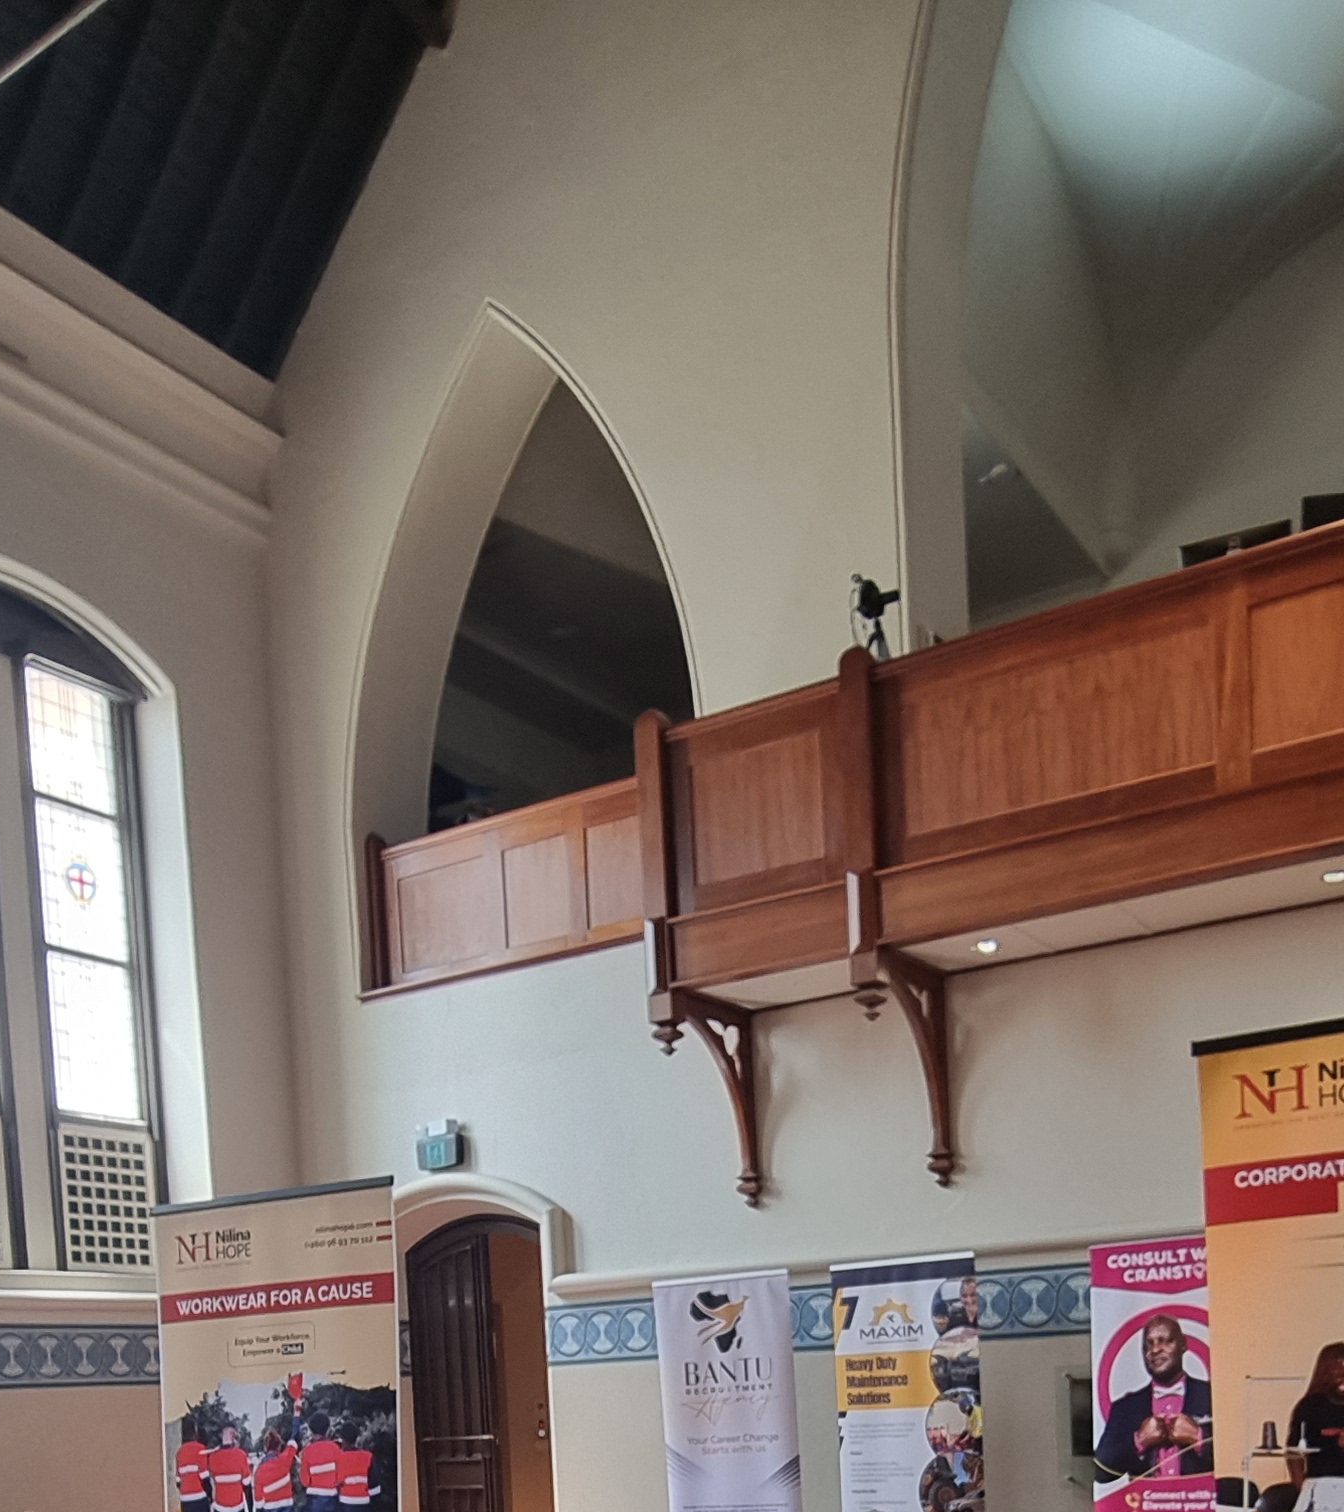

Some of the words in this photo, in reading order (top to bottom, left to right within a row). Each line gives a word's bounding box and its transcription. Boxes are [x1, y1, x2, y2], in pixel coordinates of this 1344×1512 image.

[215, 1227, 251, 1244] Nilina
[216, 1242, 252, 1259] HOPE
[1106, 1248, 1188, 1270] CONSULT
[1123, 1261, 1206, 1284] CRANSTO
[176, 1292, 266, 1316] WORKWEAR
[270, 1288, 302, 1307] FOR
[304, 1287, 316, 1303] A
[317, 1281, 373, 1302] CAUSE
[859, 1324, 924, 1340] MAXIM
[684, 1357, 773, 1386] BANTU
[876, 1357, 897, 1371] Duty
[846, 1374, 908, 1389] Maintenance
[847, 1391, 891, 1406] Solutions
